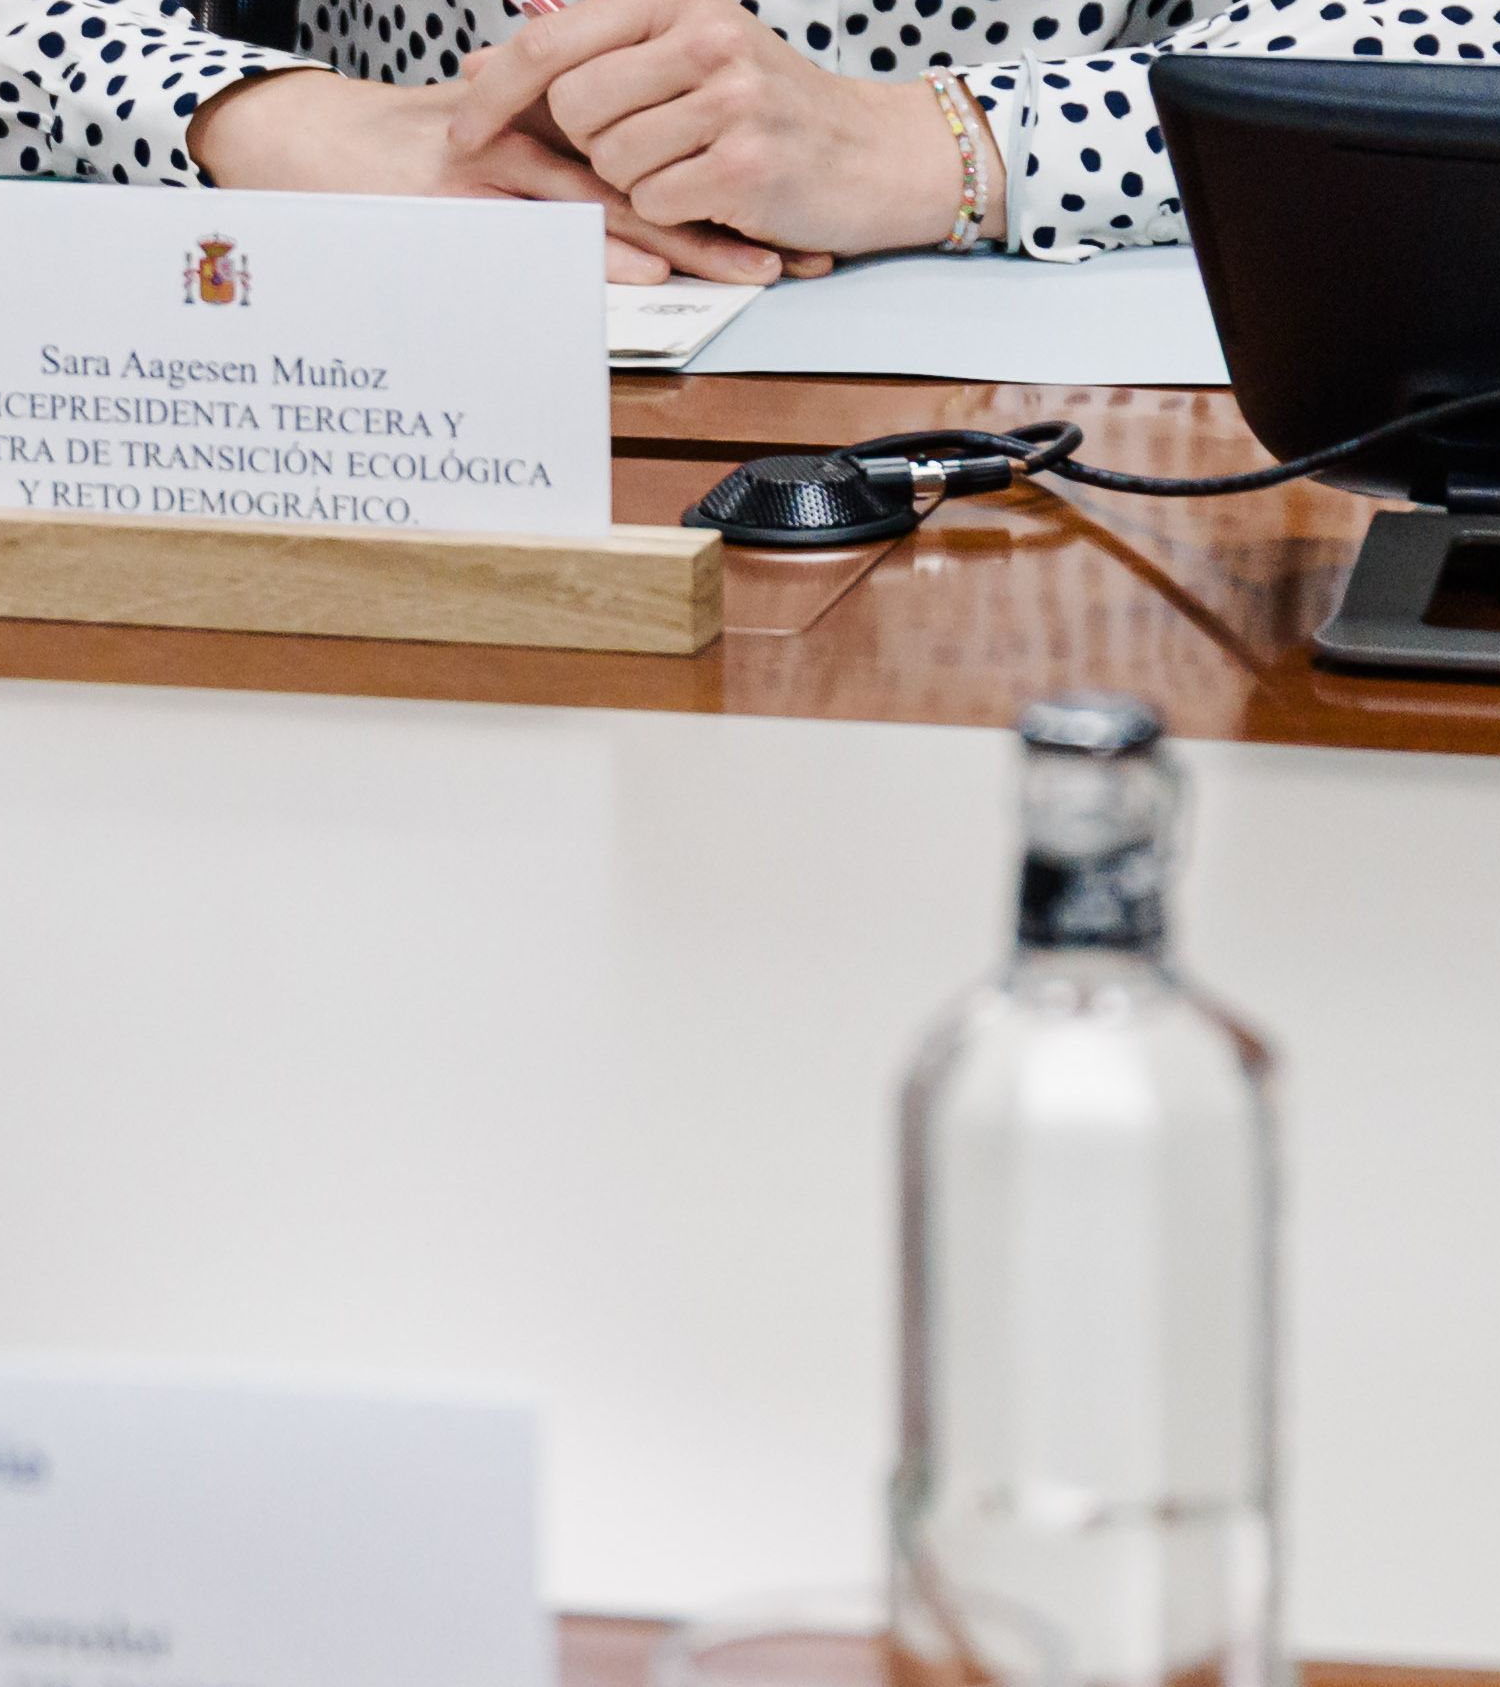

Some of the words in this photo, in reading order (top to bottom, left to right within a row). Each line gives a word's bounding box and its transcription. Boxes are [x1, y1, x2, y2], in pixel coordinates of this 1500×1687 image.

[40, 343, 112, 379] Sara
[119, 348, 259, 392] Aagesen
[271, 352, 390, 392] Muñoz
[269, 402, 434, 440] TERCERA
[440, 410, 465, 441] Y
[65, 437, 113, 468] DE
[119, 439, 334, 479] TRANSICIÓN
[346, 447, 553, 489] ECOLÓGICA
[17, 478, 41, 507] Y
[50, 479, 143, 513] RETO
[151, 484, 419, 525] DEMOGRÁFICO.
